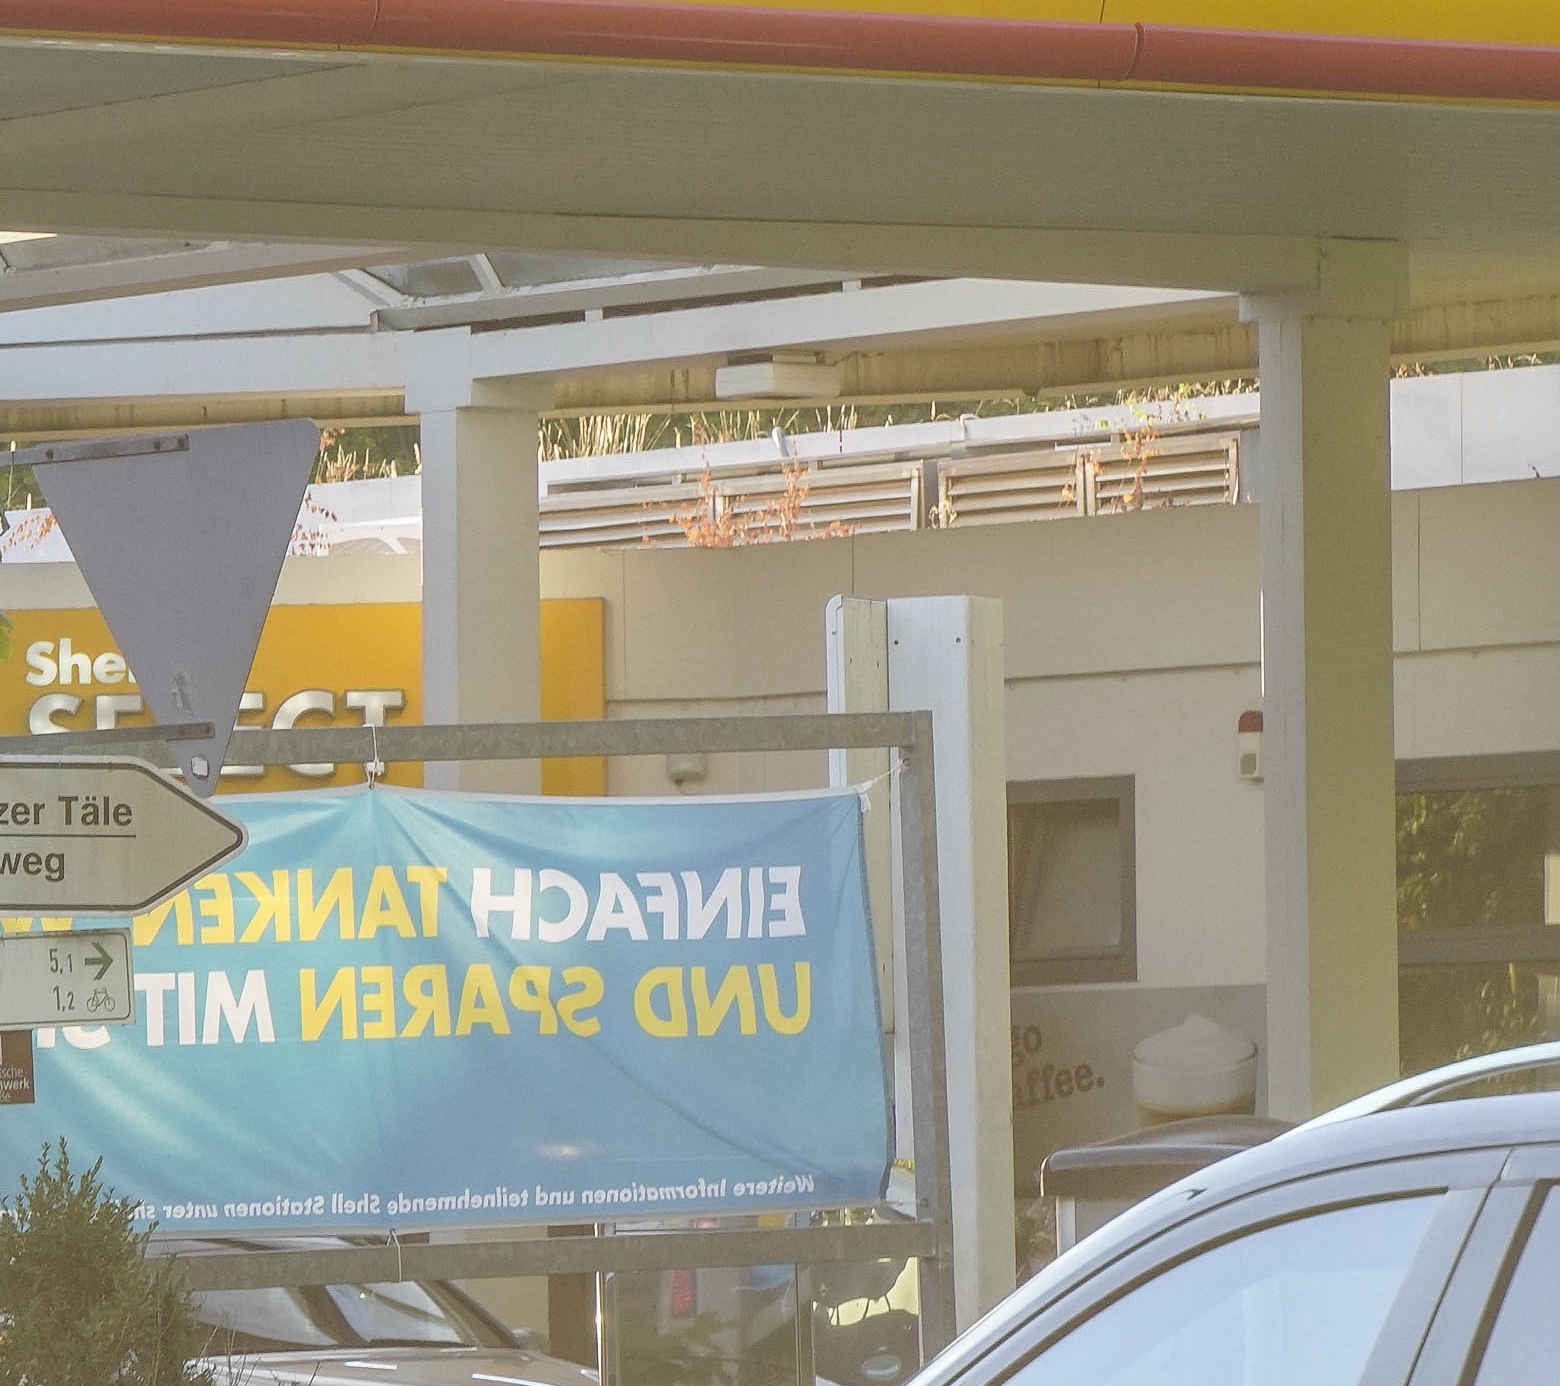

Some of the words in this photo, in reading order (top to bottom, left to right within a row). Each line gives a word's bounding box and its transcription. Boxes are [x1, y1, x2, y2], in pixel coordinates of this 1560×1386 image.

[25, 638, 136, 686] She
[58, 794, 133, 827] Täle
[49, 948, 73, 974] 5,1
[53, 986, 75, 1012] 1,2
